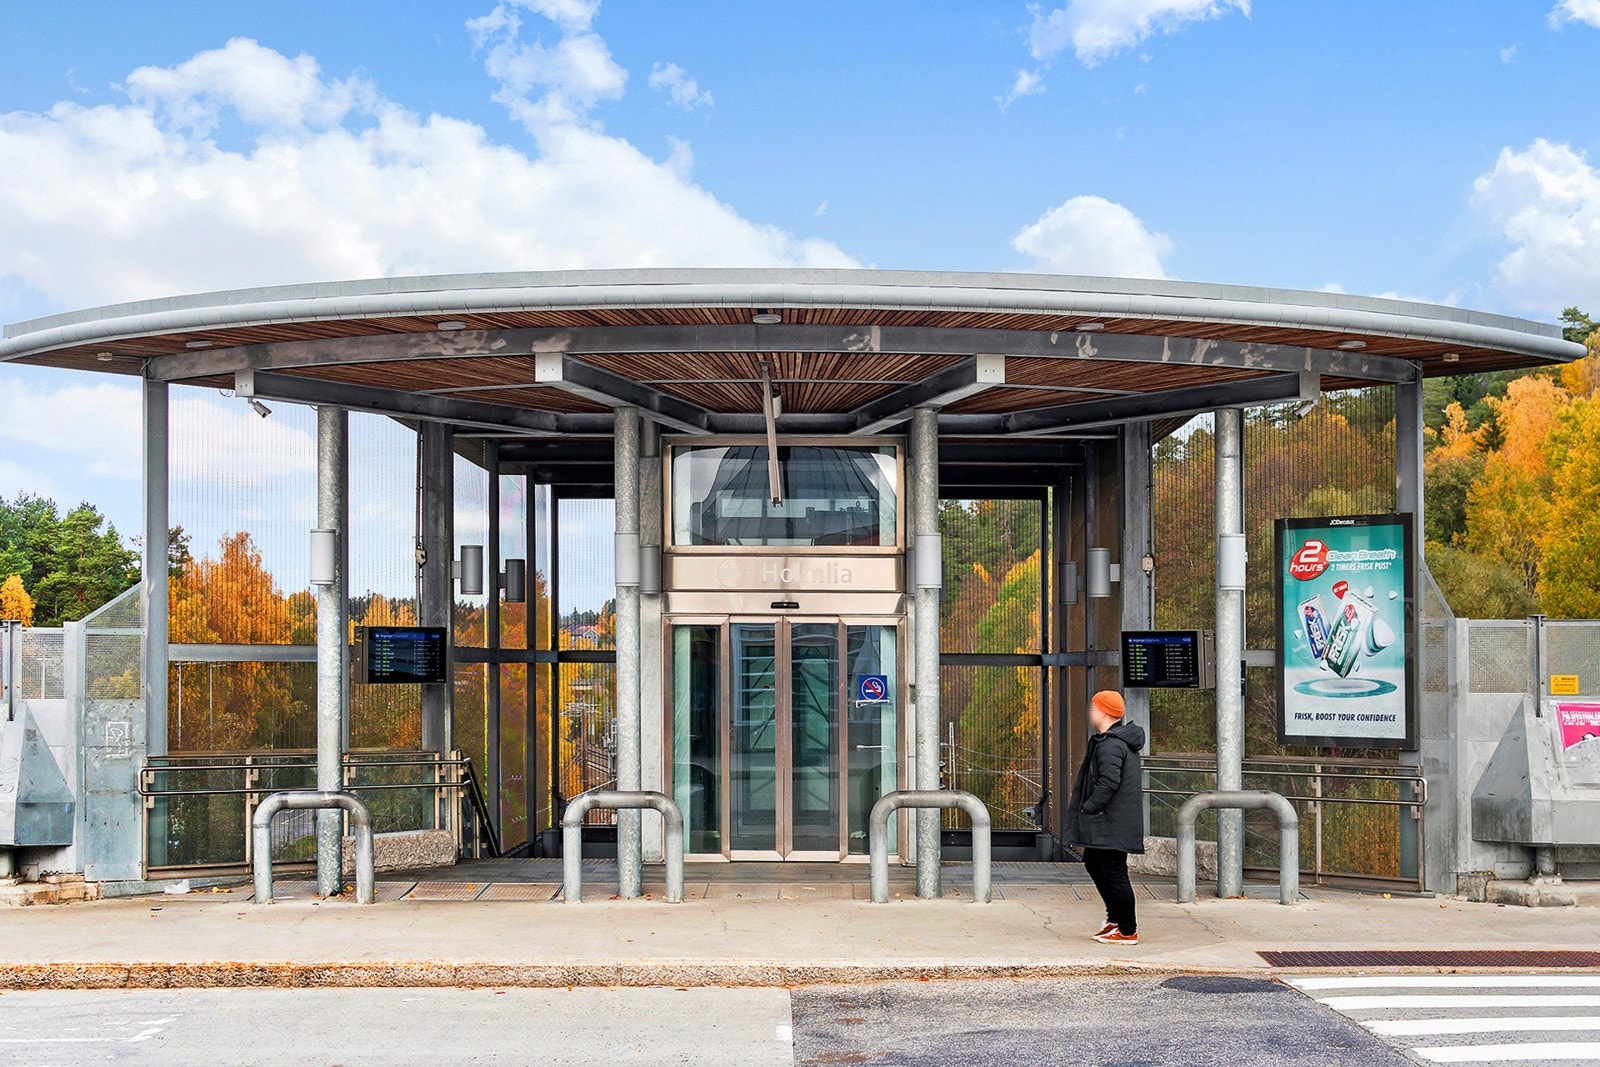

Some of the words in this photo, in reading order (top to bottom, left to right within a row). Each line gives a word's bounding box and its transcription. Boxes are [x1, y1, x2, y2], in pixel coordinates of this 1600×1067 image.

[1299, 540, 1323, 563] 2
[1326, 550, 1358, 562] Clean
[1358, 548, 1397, 561] Breath
[761, 562, 853, 584] Holmlia
[1357, 562, 1374, 571] FRISK
[1327, 618, 1351, 664] FRISK
[1294, 712, 1314, 722] FRISK,
[1315, 712, 1336, 721] BOOST
[1337, 713, 1356, 721] YOUR
[1356, 713, 1397, 722] CONFIDENCE
